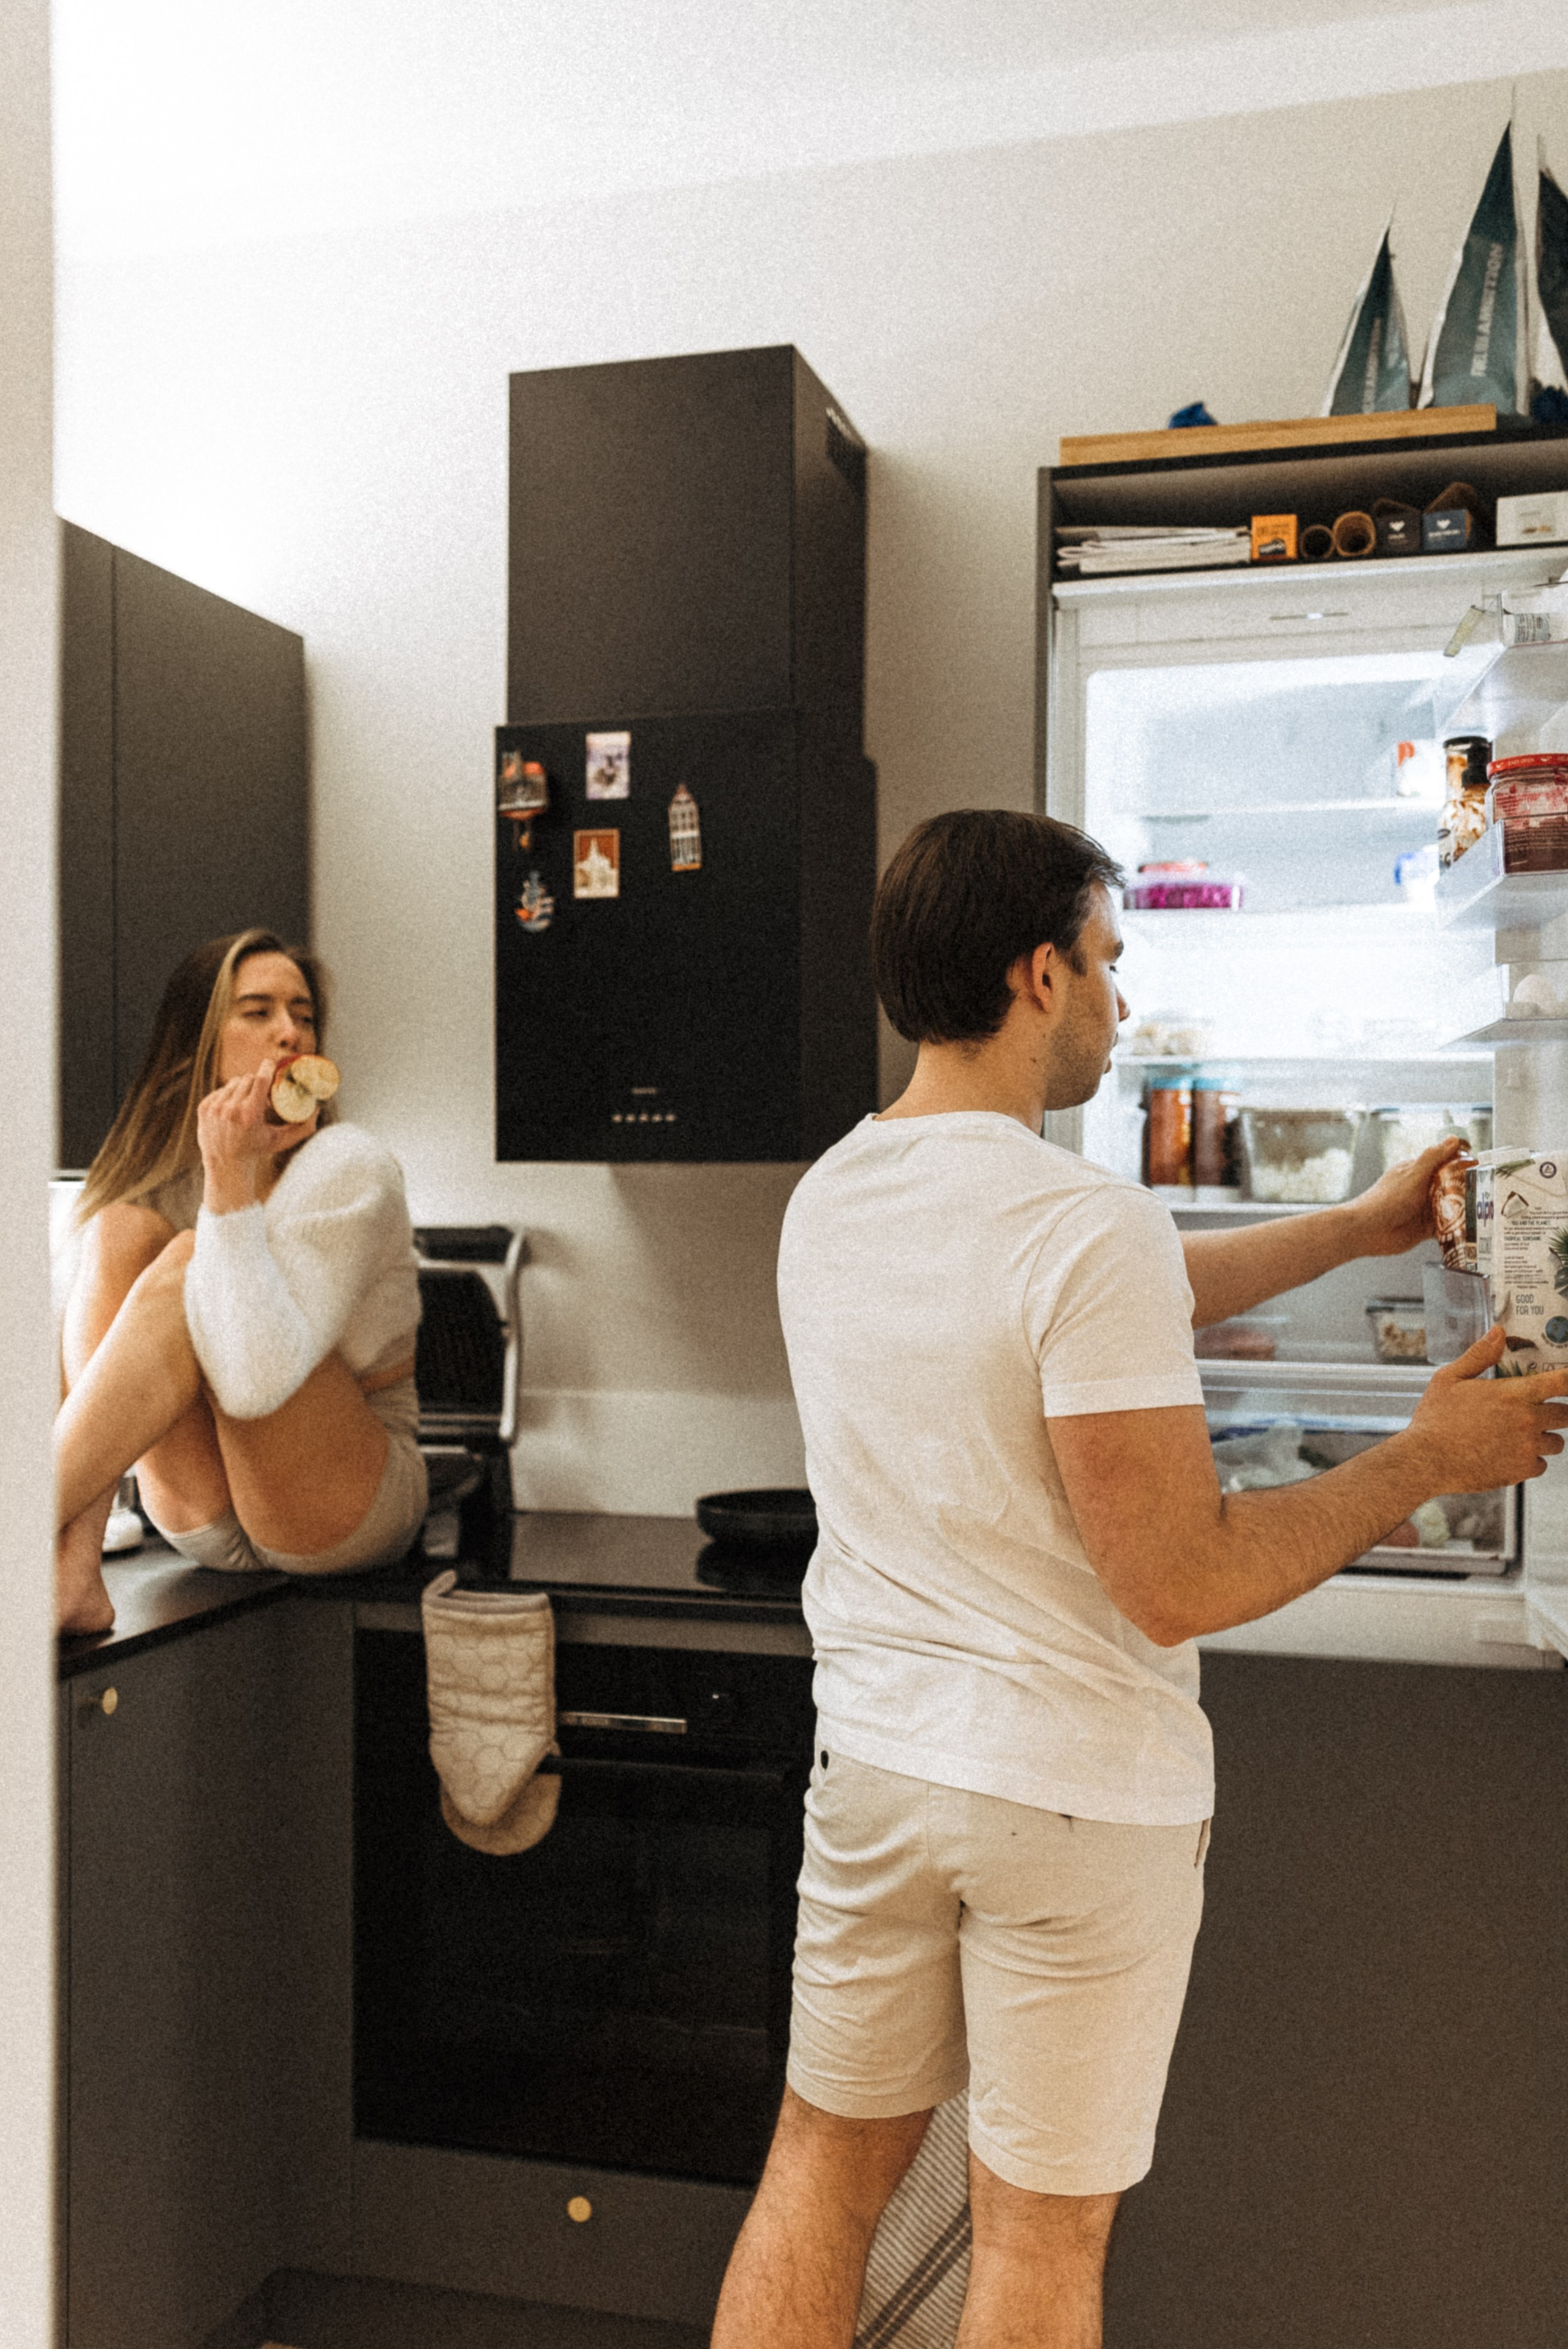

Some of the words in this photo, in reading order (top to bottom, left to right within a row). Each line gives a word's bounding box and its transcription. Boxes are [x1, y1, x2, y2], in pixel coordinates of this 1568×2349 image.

[1516, 1294, 1534, 1303] GOOD
[1516, 1305, 1529, 1315] FOR
[1531, 1305, 1544, 1315] YOU
